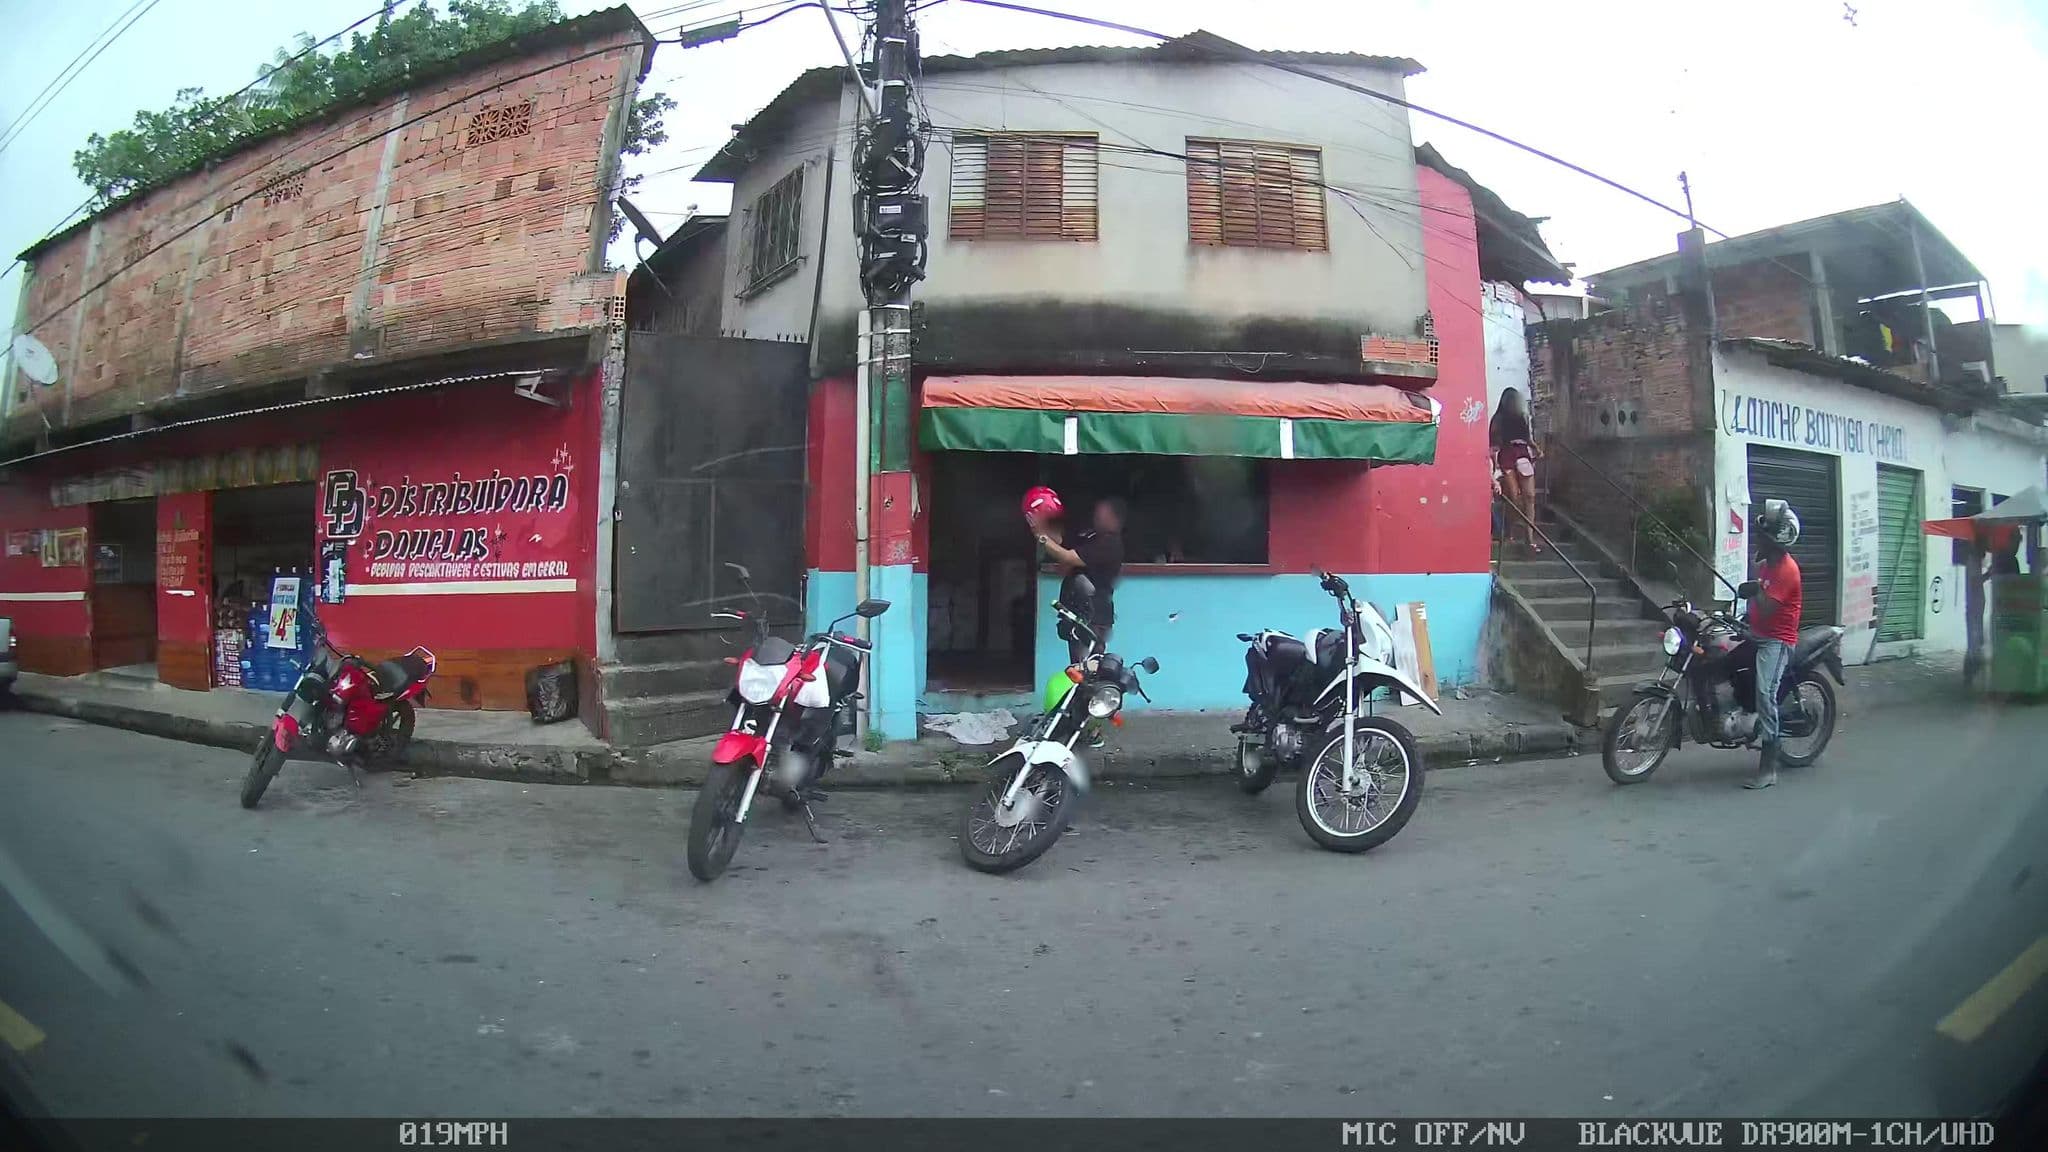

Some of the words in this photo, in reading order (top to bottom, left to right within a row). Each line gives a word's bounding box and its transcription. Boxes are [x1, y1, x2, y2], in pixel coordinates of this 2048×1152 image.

[480, 561, 519, 578] ESTIVAS
[522, 562, 537, 578] EM
[537, 561, 569, 577] GERAL
